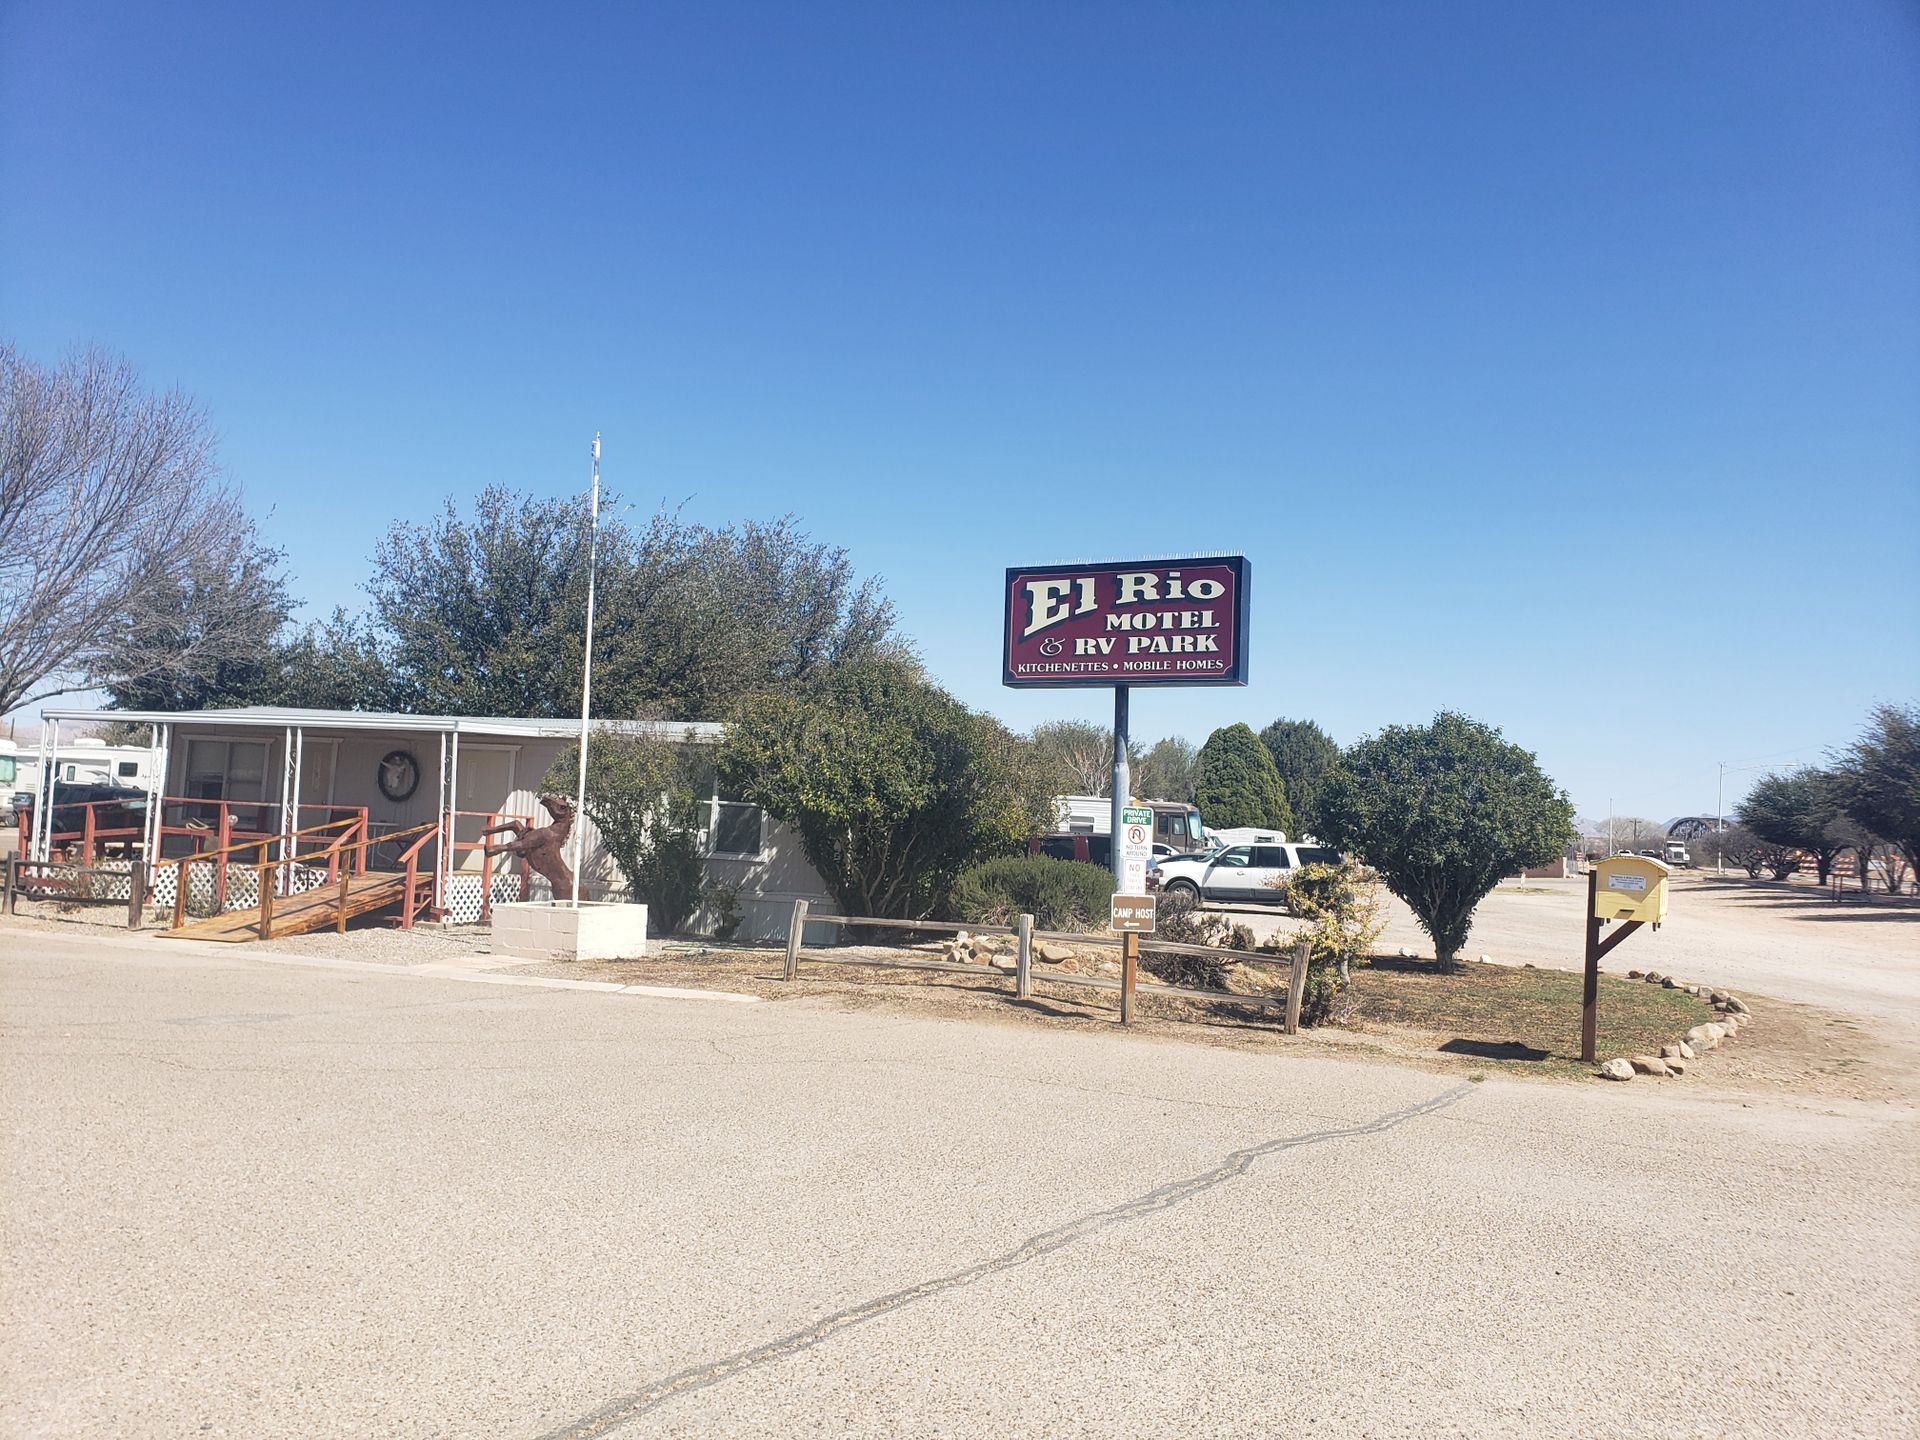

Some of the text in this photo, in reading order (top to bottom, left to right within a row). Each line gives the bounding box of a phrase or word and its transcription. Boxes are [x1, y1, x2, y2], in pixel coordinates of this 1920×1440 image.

[1024, 571, 1226, 637] El Rio
[1106, 610, 1220, 631] MOTEL
[1039, 634, 1219, 656] & RV PARK
[1018, 659, 1224, 673] KITCHENETTES MOBILE HOMES
[1123, 808, 1151, 818] PRIVATE
[1127, 816, 1147, 824] DRIVE
[1129, 864, 1141, 872] NO
[1113, 907, 1154, 919] CAMP HOST
